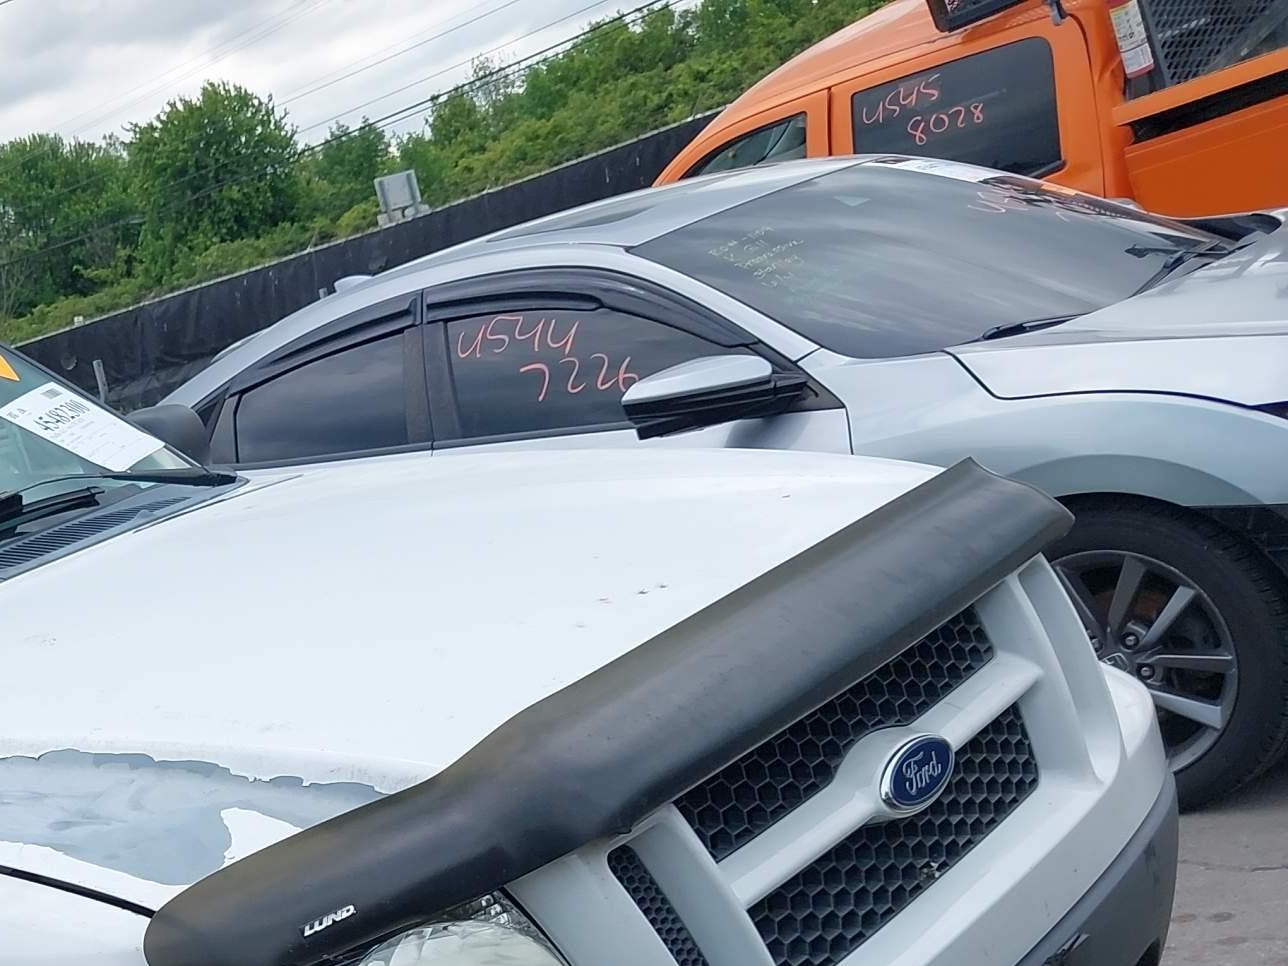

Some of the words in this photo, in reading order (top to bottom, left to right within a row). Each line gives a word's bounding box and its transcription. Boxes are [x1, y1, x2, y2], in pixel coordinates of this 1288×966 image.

[907, 103, 984, 145] 8028
[519, 353, 639, 402] 7226
[33, 399, 90, 432] 45482300
[903, 751, 942, 795] Ford
[304, 904, 355, 937] LUND
